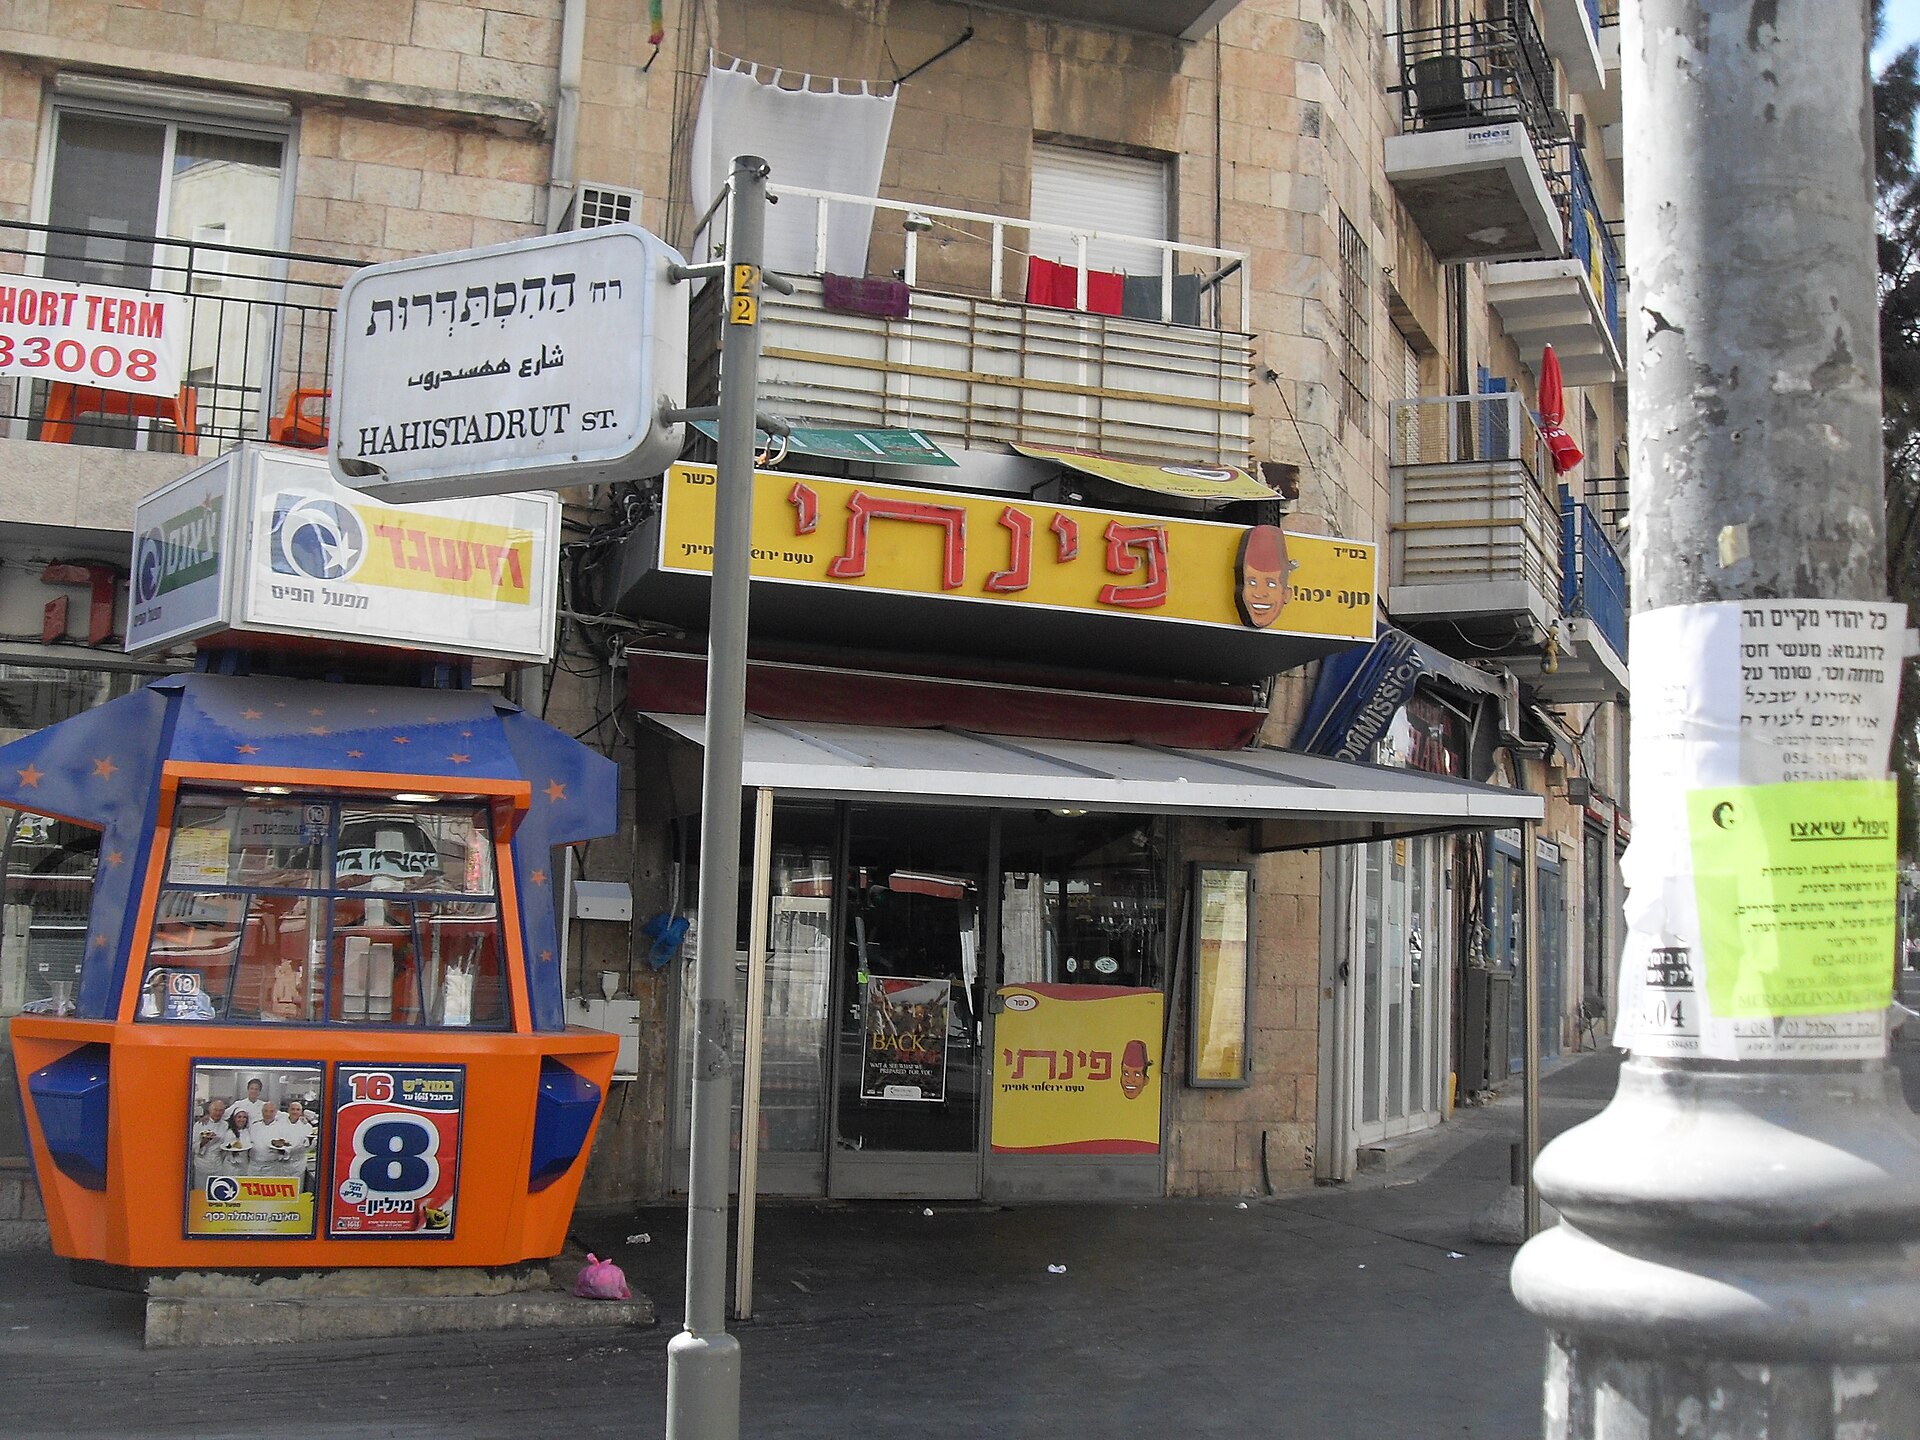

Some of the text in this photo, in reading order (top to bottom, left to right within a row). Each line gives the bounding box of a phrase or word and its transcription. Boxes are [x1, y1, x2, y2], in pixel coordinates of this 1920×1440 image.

[0, 286, 165, 339] HORT TERM
[737, 298, 750, 321] 2
[518, 343, 564, 378] شارع
[358, 403, 618, 457] HAHISTADRUT ST.
[682, 472, 715, 485] כשר
[786, 481, 1170, 608] פינתי
[374, 523, 525, 589] חישגד
[783, 551, 814, 565] טעם
[271, 584, 369, 610] מפעל הפיס
[1293, 585, 1371, 608] מנה יפה!
[1742, 609, 1888, 631] כל יהודי מקיים הר
[1776, 643, 1822, 658] מעשי
[1827, 645, 1885, 661] לדוגמא:
[1741, 665, 1763, 681] על
[1769, 666, 1812, 680] שומר
[1334, 648, 1425, 761] OMMISSION
[1790, 820, 1846, 836] שיאצו
[872, 1031, 927, 1053] BACK
[1003, 1048, 1112, 1080] פינתי
[350, 1075, 392, 1101] 16
[1001, 1082, 1085, 1093] טעם ירושלמי אמיתי
[360, 1122, 430, 1192] 8
[240, 1183, 295, 1197] חישגד
[202, 1211, 225, 1222] כסף.
[227, 1210, 254, 1220] אחלה
[256, 1212, 267, 1220] זה
